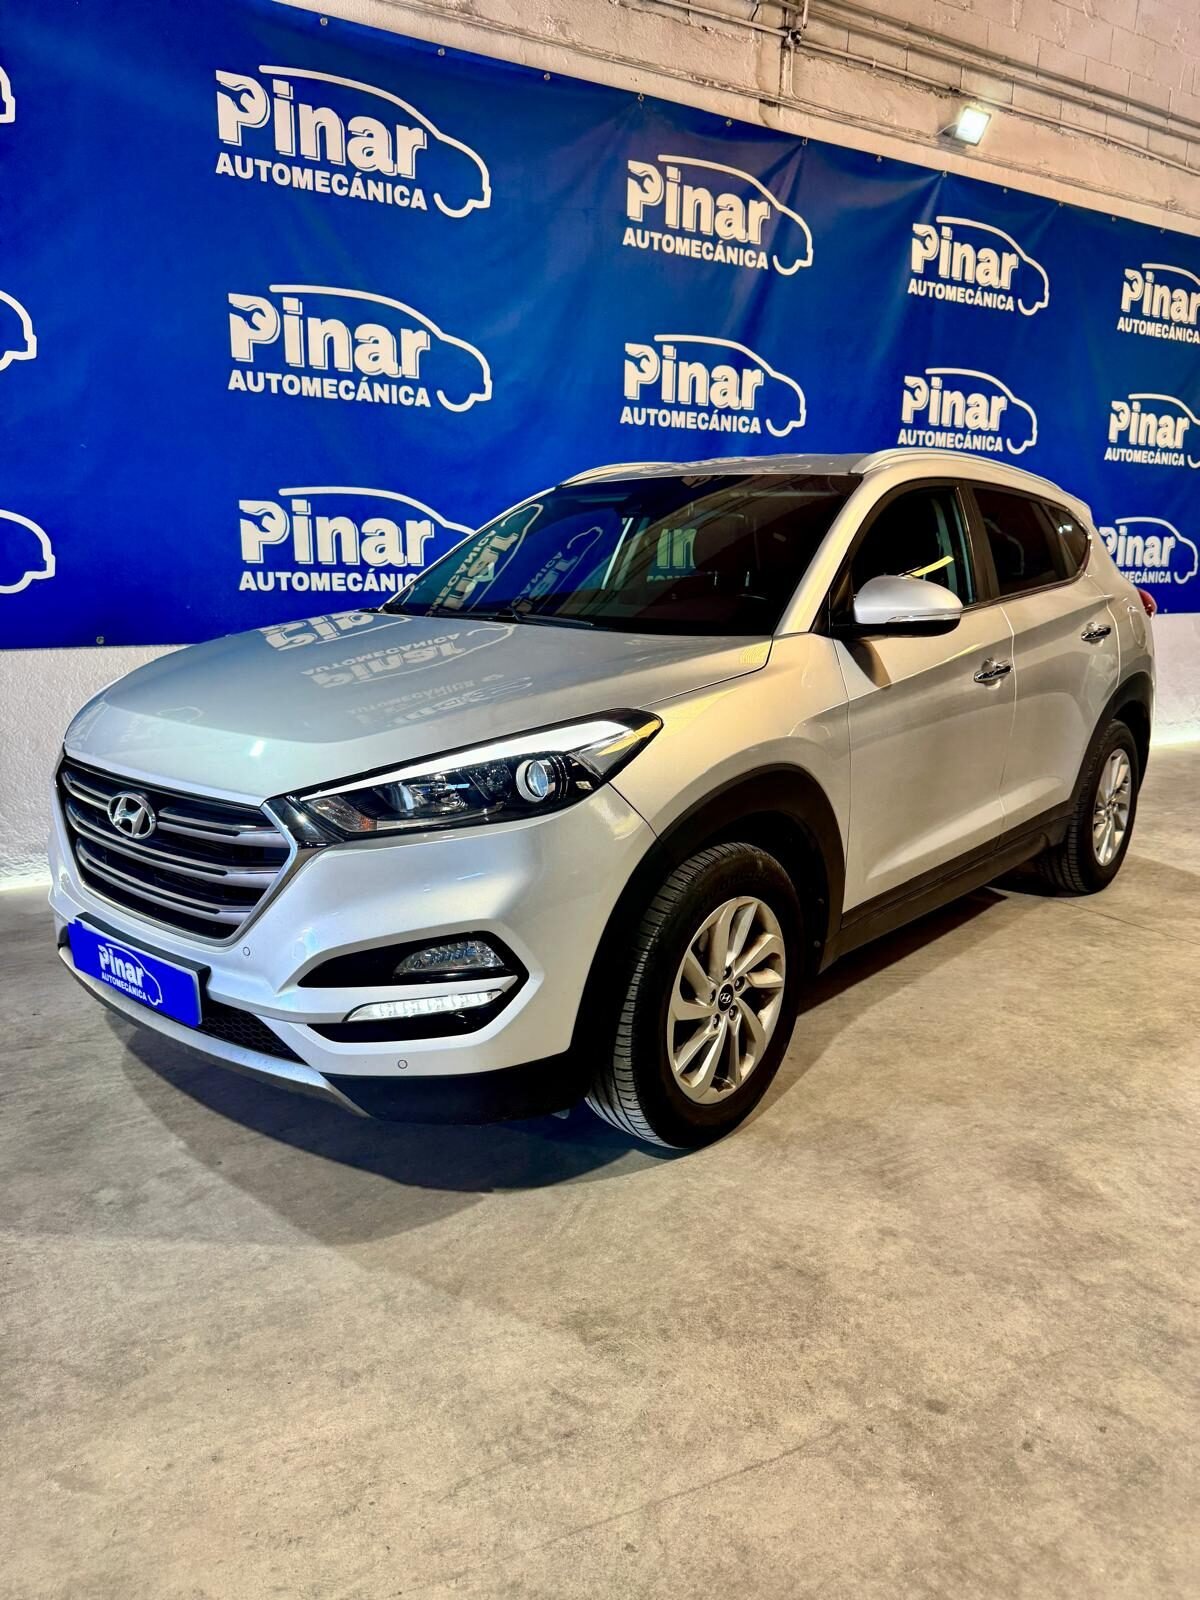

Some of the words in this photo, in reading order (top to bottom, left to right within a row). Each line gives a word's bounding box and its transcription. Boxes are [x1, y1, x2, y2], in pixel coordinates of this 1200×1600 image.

[215, 70, 428, 179] Pinar
[215, 153, 428, 211] AUTOMECÁNICA
[626, 160, 771, 246] Pinar
[622, 228, 769, 270] AUTOMECÁNICA
[911, 223, 1018, 290] Pinar
[907, 278, 1015, 312] AUTOMECÁNICA
[1120, 268, 1200, 325] Pinar
[227, 293, 431, 379] Pinar
[1116, 316, 1200, 344] AUTOMECÁNICA
[227, 370, 431, 407] AUTOMECÁNICA
[623, 343, 765, 411] Pinar
[901, 375, 1008, 431] Pinar
[619, 407, 762, 434] AUTOMECÁNICA
[897, 428, 1004, 452] AUTOMECÁNICA
[1108, 400, 1191, 449] Pinar
[1103, 447, 1185, 466] AUTOMECÁNICA
[238, 498, 435, 567] Pinar
[238, 568, 420, 592] AUTOMECÁNIC
